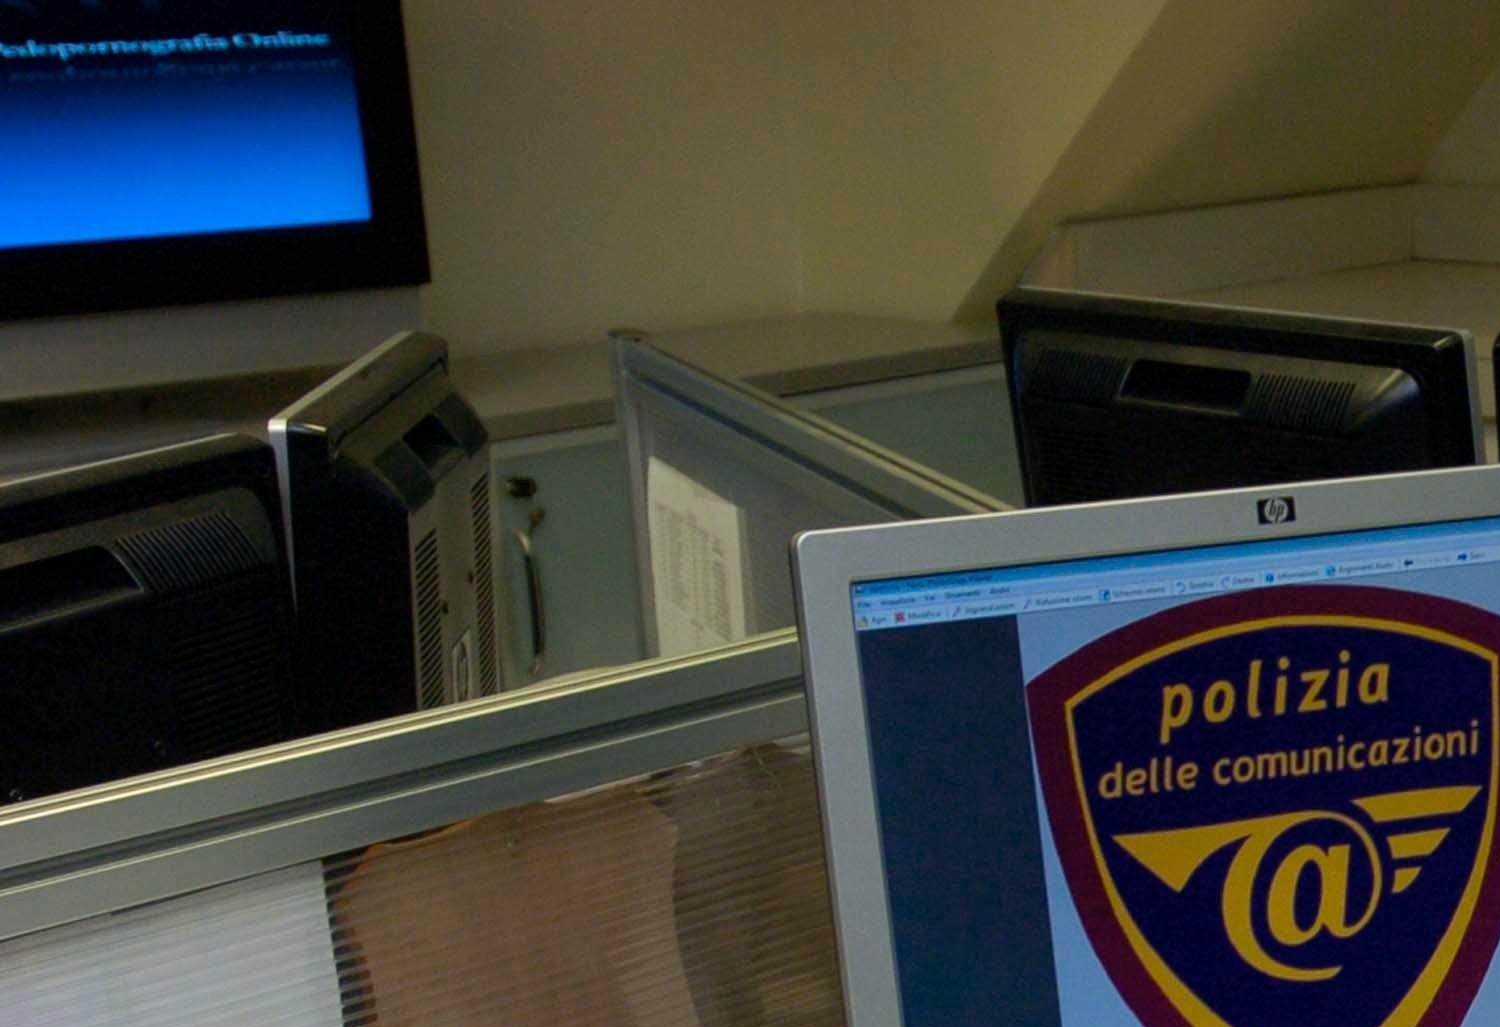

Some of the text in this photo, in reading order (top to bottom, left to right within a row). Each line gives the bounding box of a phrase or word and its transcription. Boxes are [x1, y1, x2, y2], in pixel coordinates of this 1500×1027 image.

[1262, 498, 1291, 524] hp
[1160, 650, 1390, 744] polizia
[1099, 719, 1479, 799] delle comunicazioni
